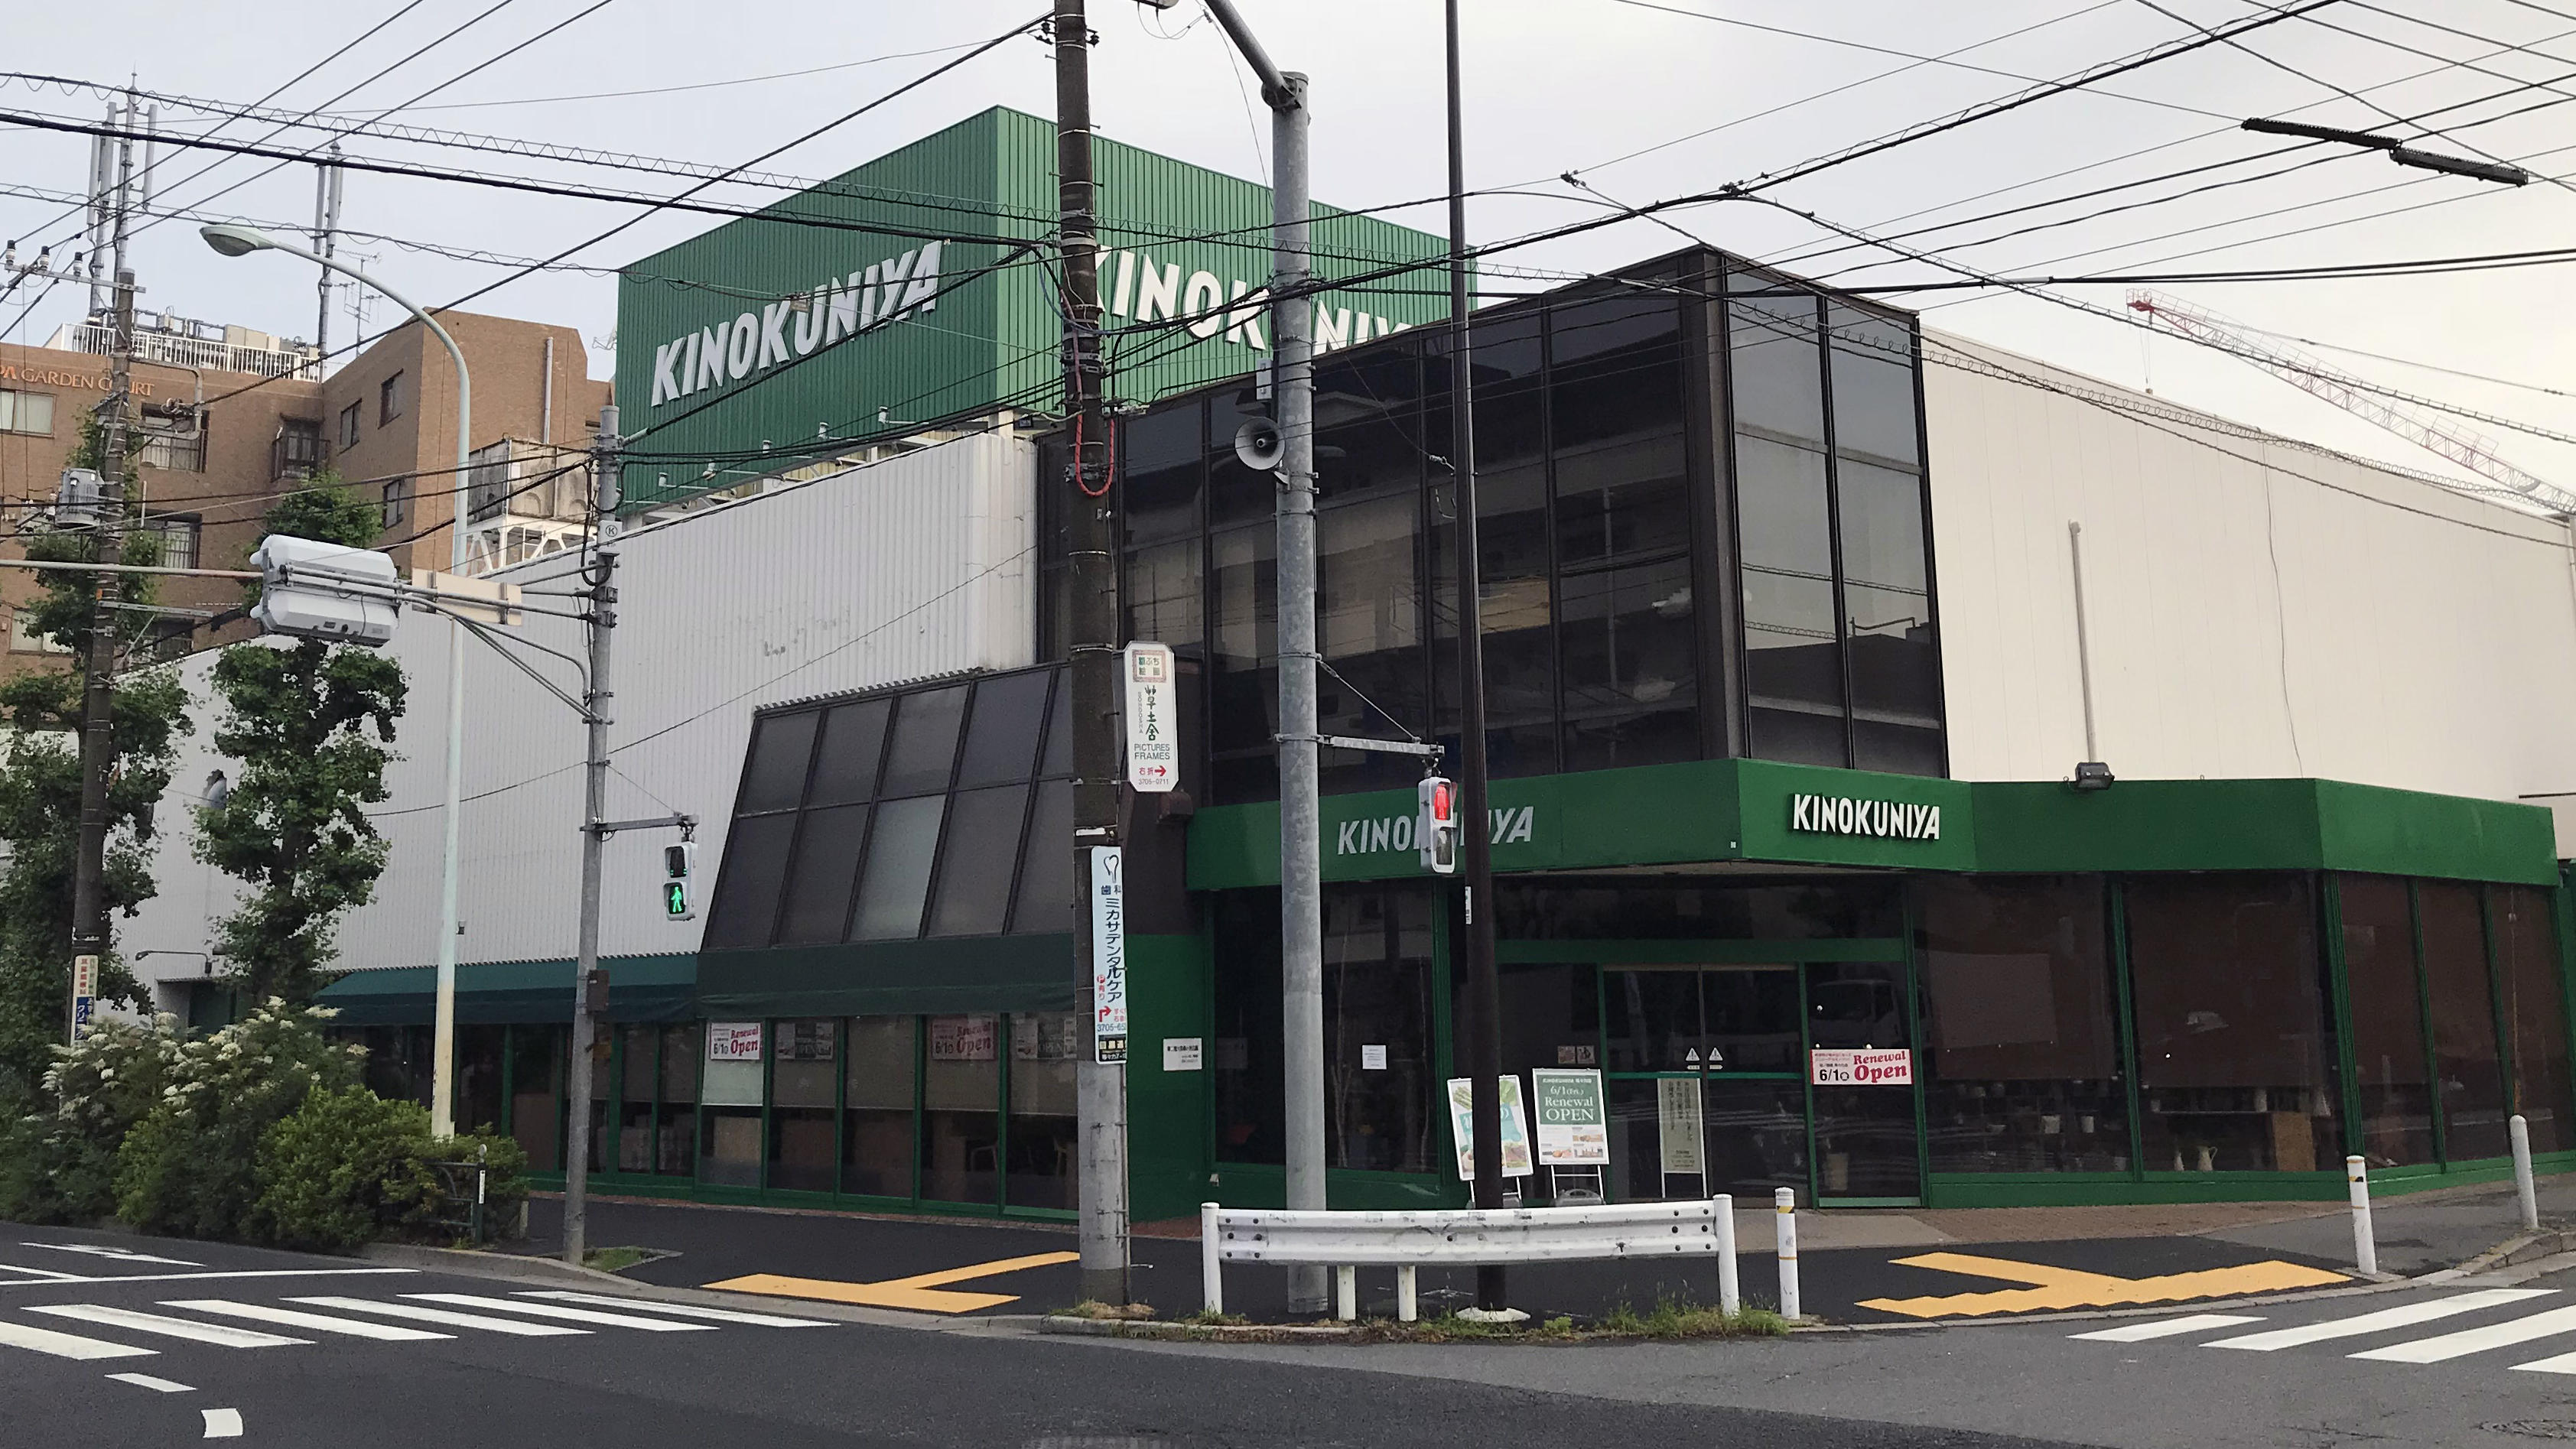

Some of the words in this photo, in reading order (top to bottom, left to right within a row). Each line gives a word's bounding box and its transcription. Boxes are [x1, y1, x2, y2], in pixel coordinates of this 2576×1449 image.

[651, 239, 942, 408] KINOKUNIYA
[21, 368, 93, 388] GARDEN
[1134, 743, 1170, 752] PICTURES
[1134, 752, 1170, 760] FRAMES
[1793, 794, 1940, 840] KINOKUNIYA
[1104, 898, 1123, 1003] ミカサデンタルケア
[730, 1025, 759, 1039] Renewal
[730, 1039, 759, 1056] Open
[957, 1036, 991, 1056] Open
[1853, 1050, 1906, 1065] Renewal
[1854, 1064, 1908, 1083] Open
[1545, 1096, 1594, 1106] Renewal
[1546, 1108, 1594, 1122] OPEN
